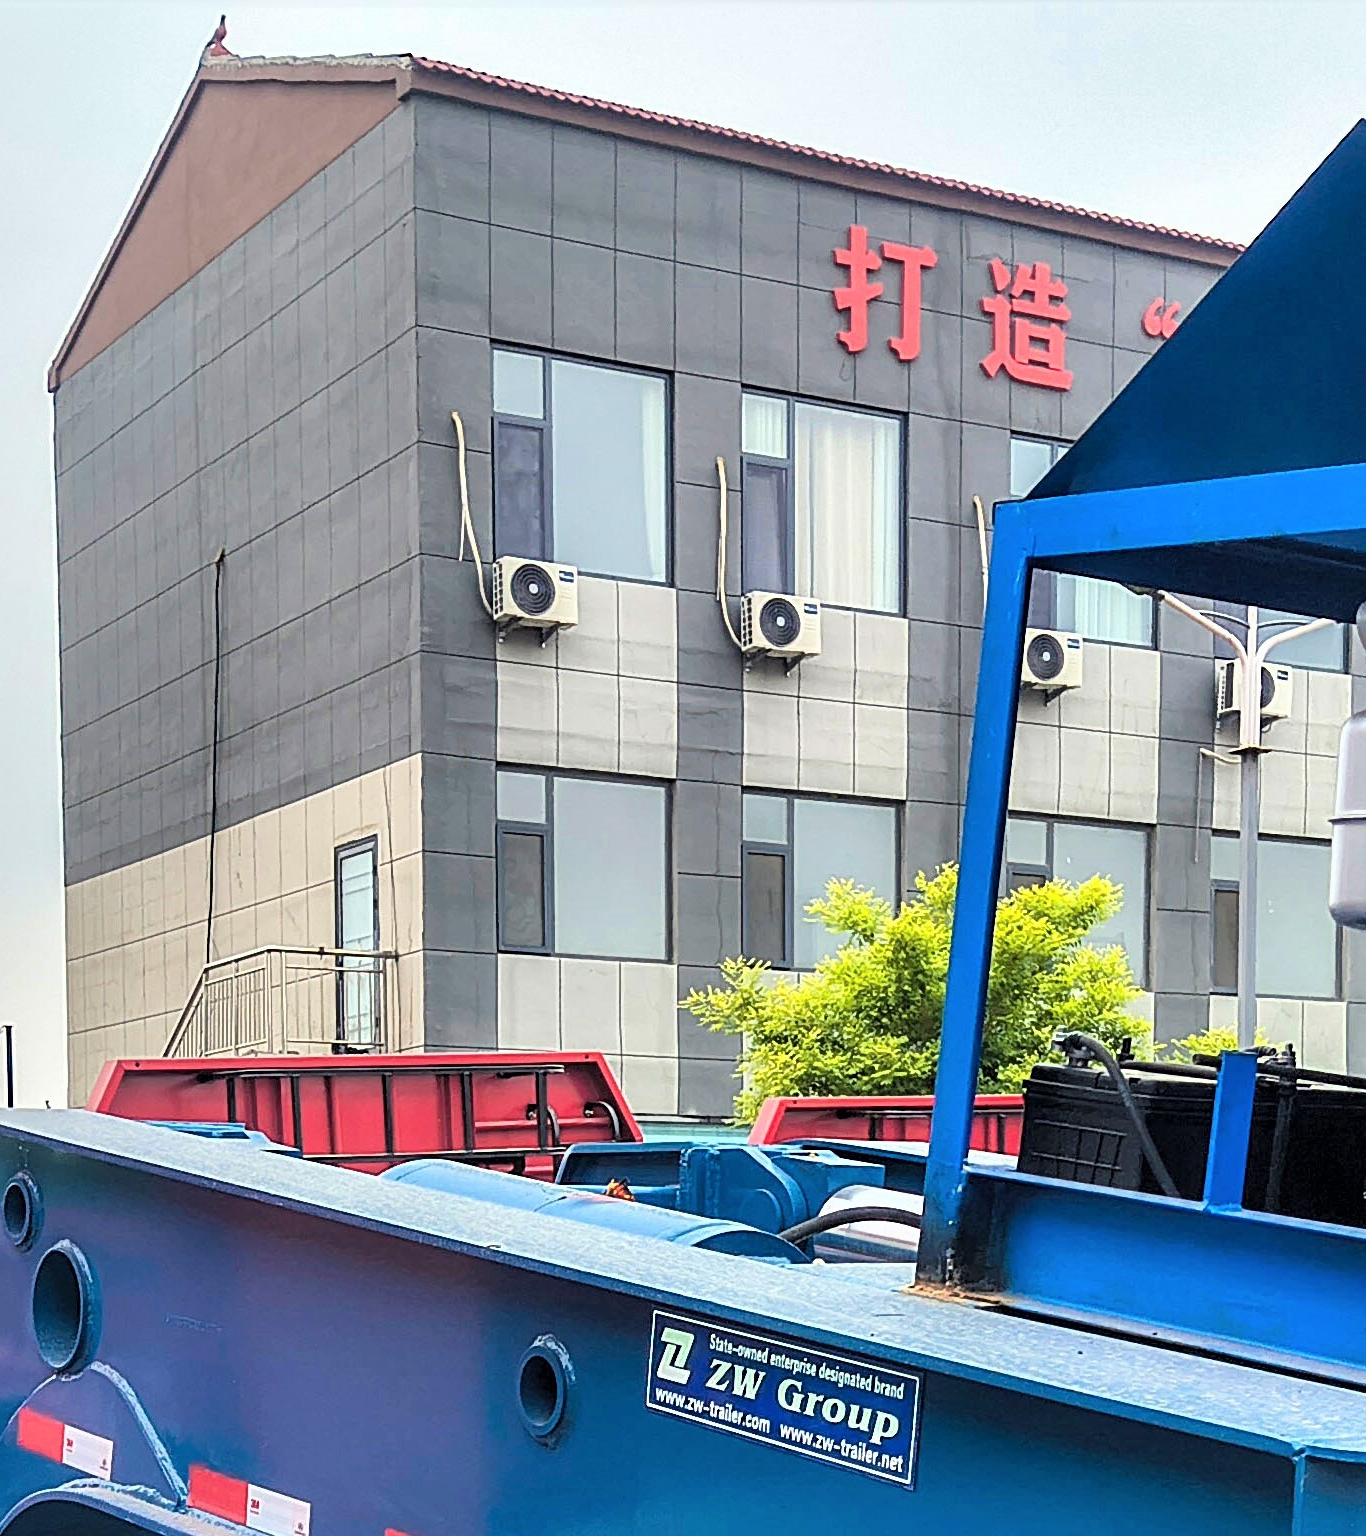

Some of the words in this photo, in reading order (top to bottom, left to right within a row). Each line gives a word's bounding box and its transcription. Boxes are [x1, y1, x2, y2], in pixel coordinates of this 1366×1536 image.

[705, 1358, 766, 1400] ZW
[777, 1378, 900, 1446] Group
[709, 1333, 769, 1364] State-owned
[769, 1353, 817, 1376] enterprise
[818, 1361, 873, 1392] designated
[873, 1375, 905, 1400] brand
[655, 1387, 771, 1434] www.zw-trailer.com
[779, 1423, 904, 1473] www.zw-trailer.net
